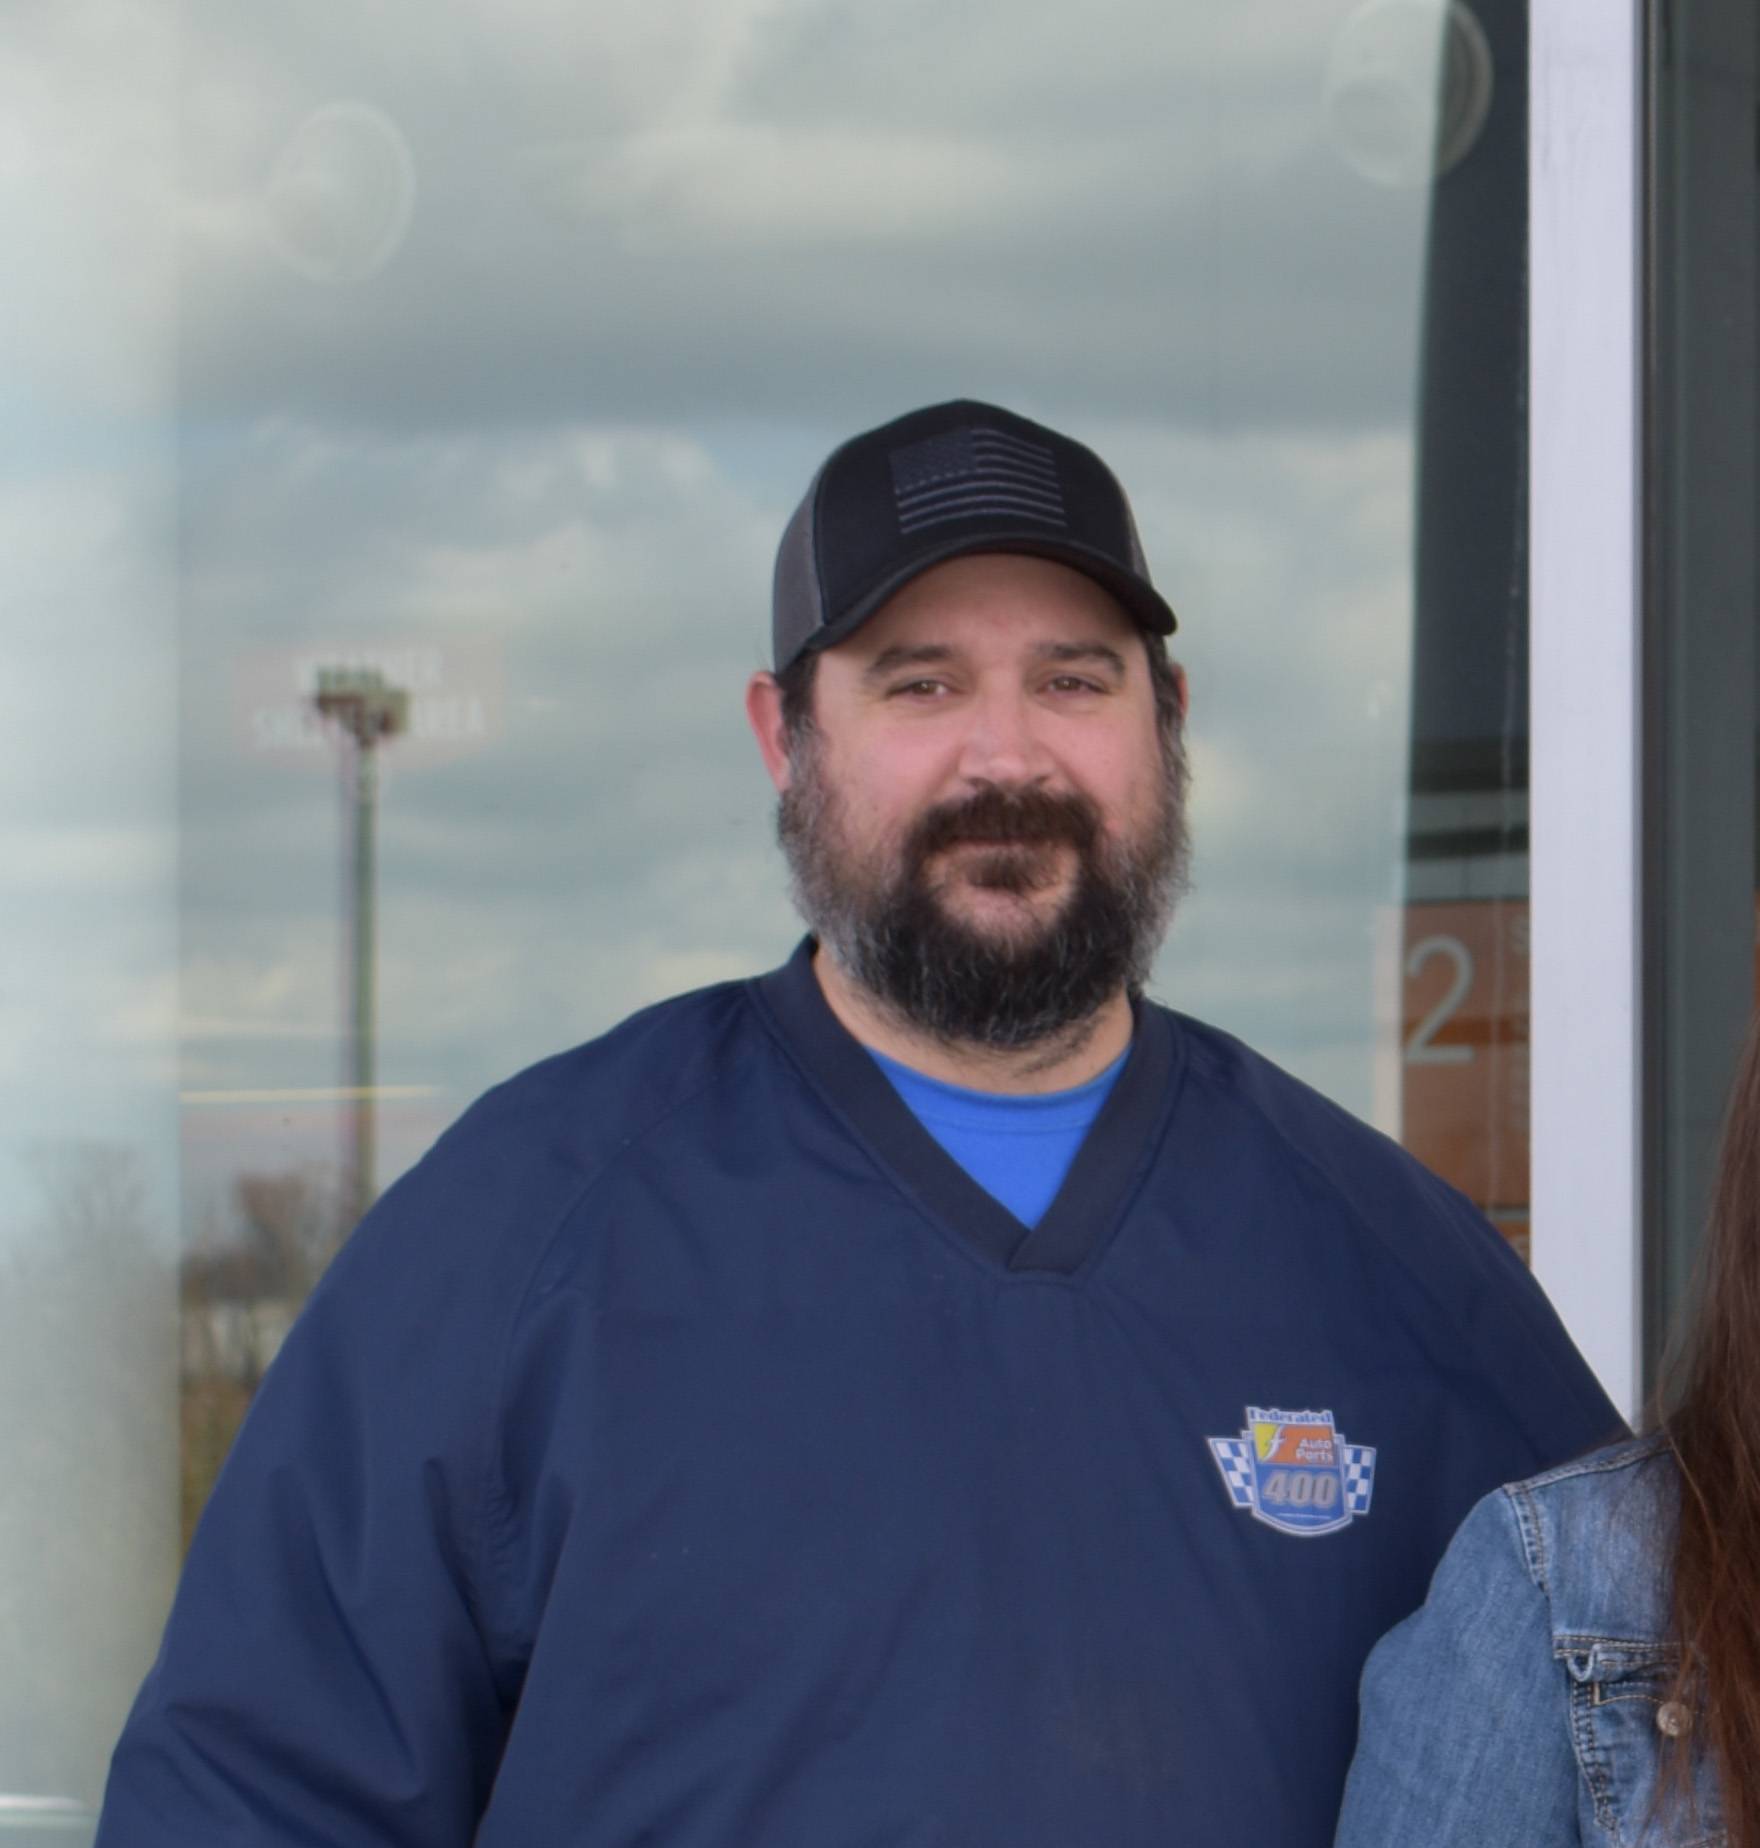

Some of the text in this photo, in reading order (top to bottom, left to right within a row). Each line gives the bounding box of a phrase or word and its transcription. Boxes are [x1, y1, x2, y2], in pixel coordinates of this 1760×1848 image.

[1404, 931, 1476, 1066] 2
[1300, 1439, 1333, 1450] Auto
[1263, 1471, 1338, 1506] 400
